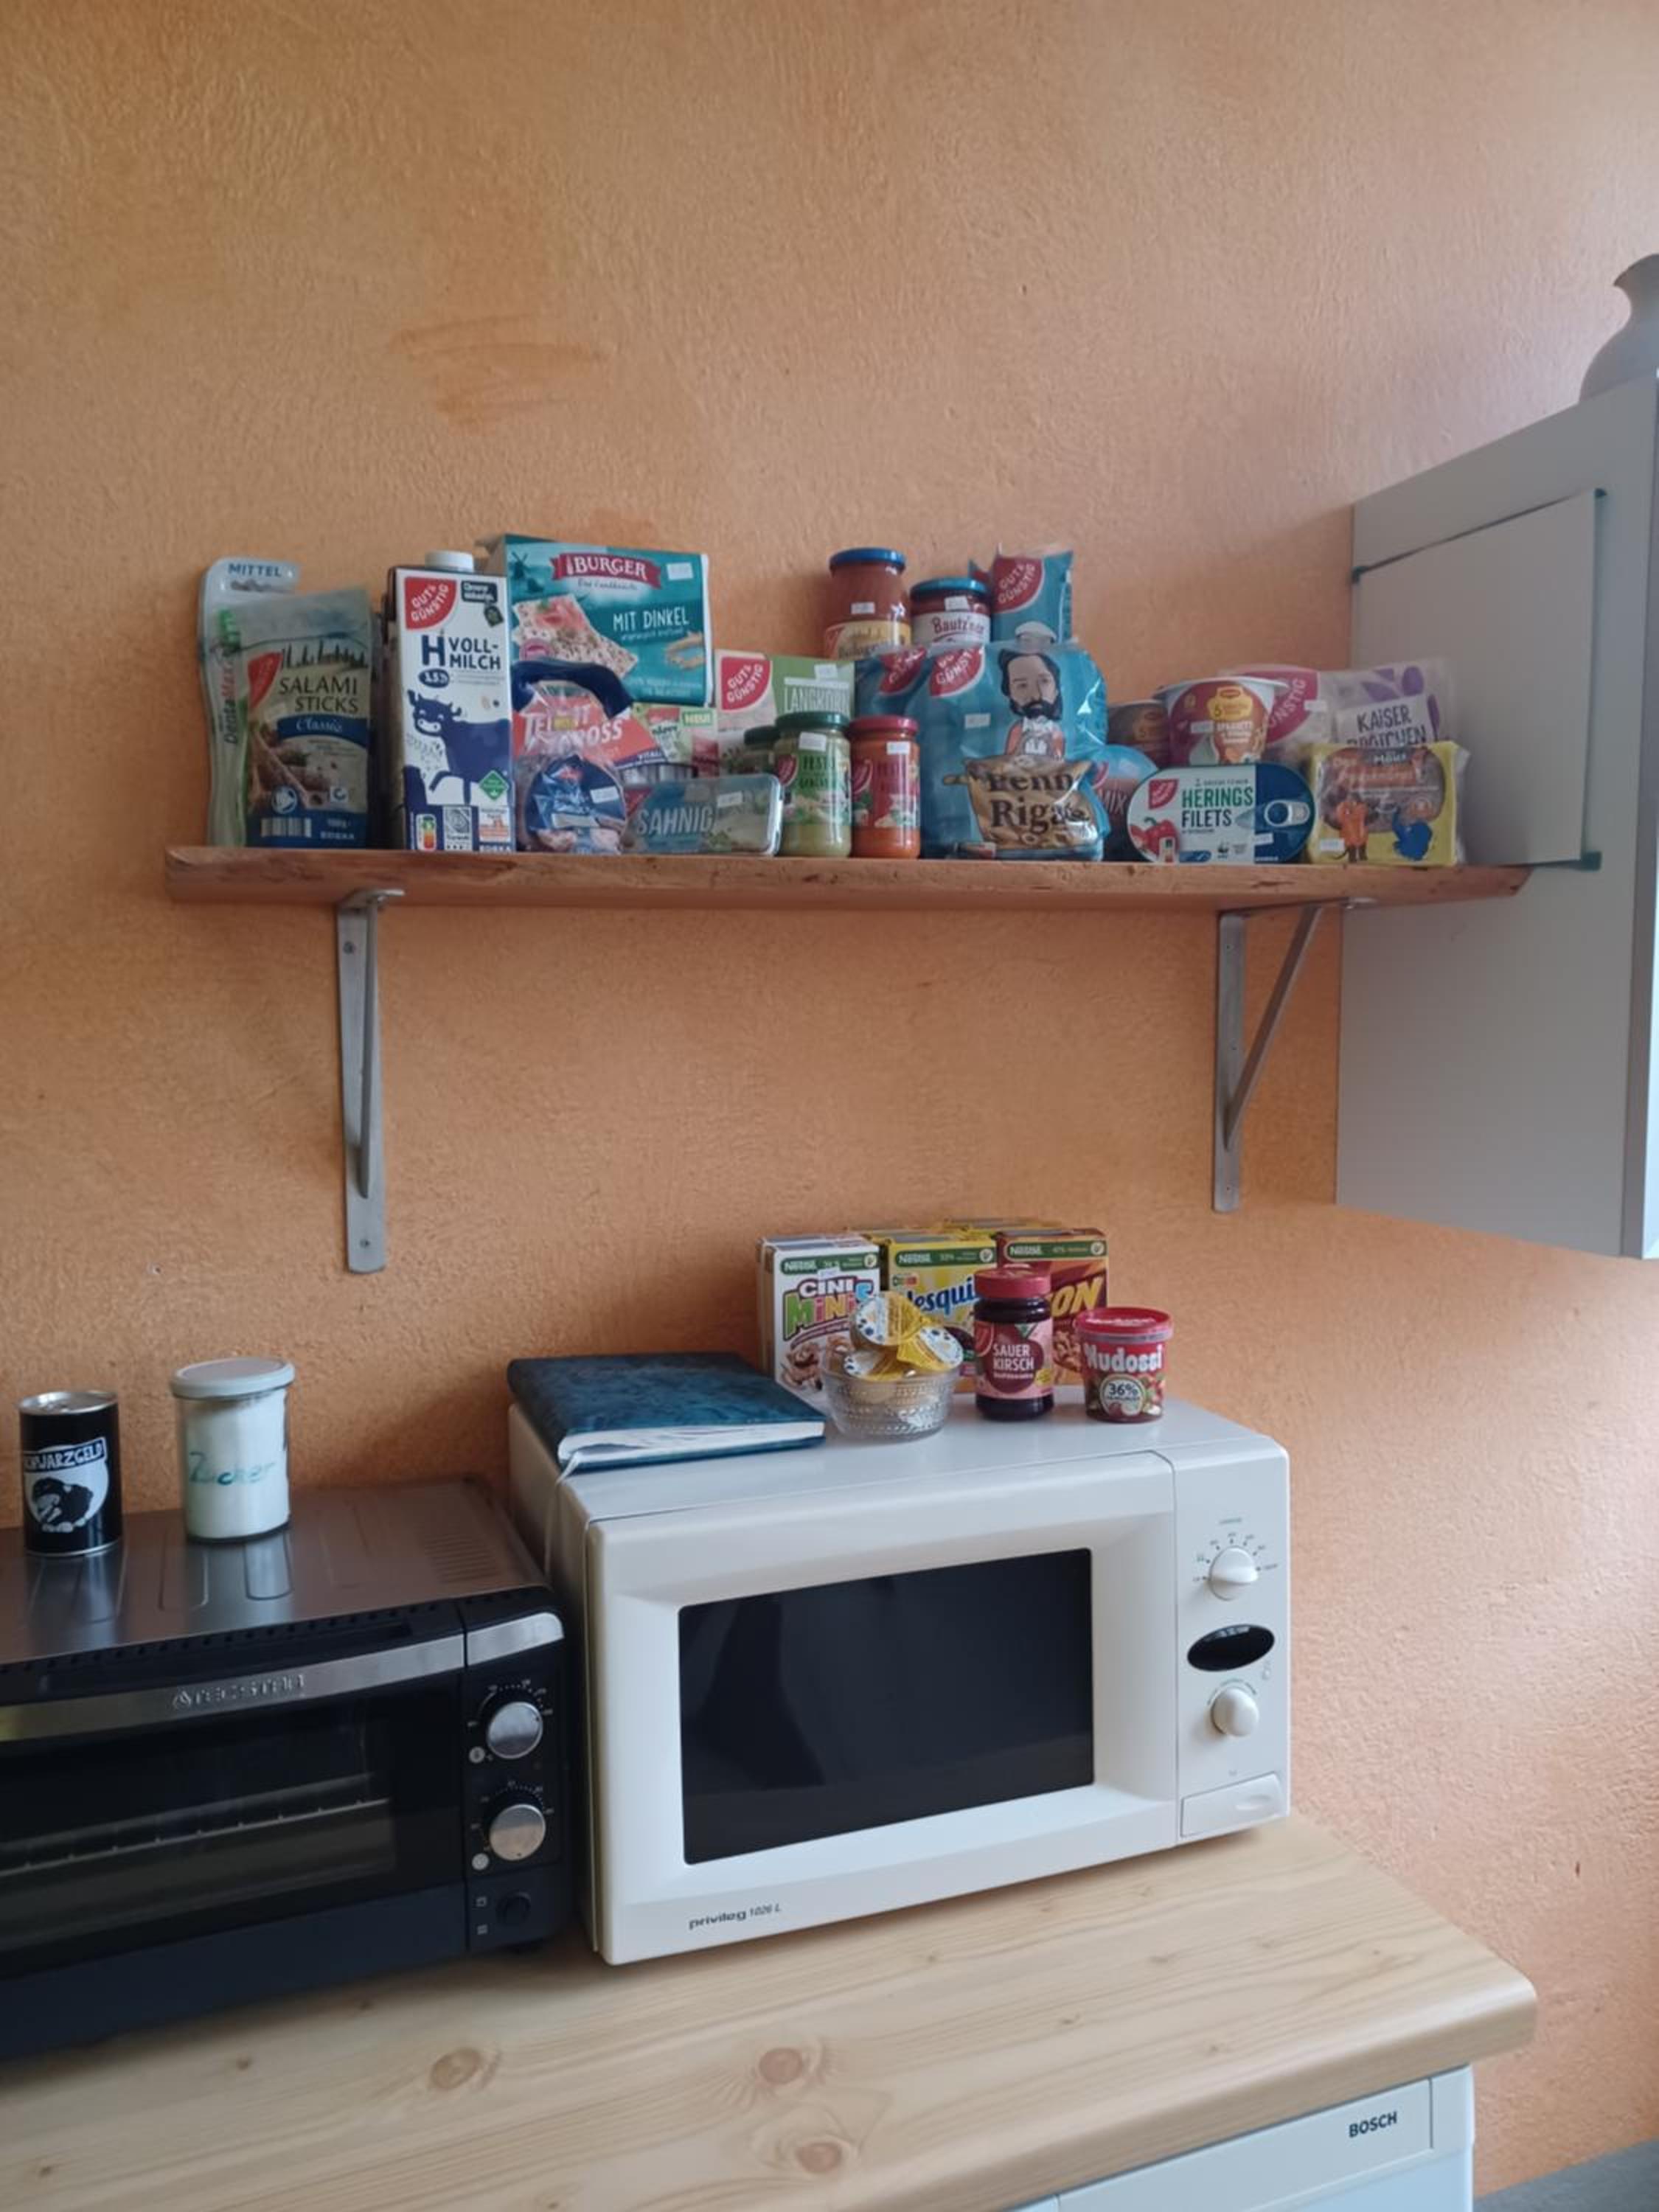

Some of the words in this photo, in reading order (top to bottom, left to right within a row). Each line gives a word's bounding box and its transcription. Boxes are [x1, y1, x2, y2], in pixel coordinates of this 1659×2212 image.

[229, 563, 282, 577] MITTEL
[573, 555, 647, 580] BURGER
[613, 612, 636, 632] MIT
[642, 606, 690, 628] DINKEL
[422, 633, 446, 667] H
[448, 637, 499, 654] VOLL-
[449, 654, 501, 670] MILCH
[279, 676, 358, 695] SALAMI
[295, 696, 359, 714] STICKS
[1182, 787, 1253, 809] HERINGS
[636, 805, 714, 835] SAHNIG
[1181, 810, 1233, 828] FILETS
[992, 1343, 1031, 1358] SAUER
[992, 1357, 1034, 1372] KIRSCH
[1108, 1382, 1139, 1397] 36%
[689, 1910, 747, 1930] privileg
[1348, 2110, 1398, 2138] BOSCH
